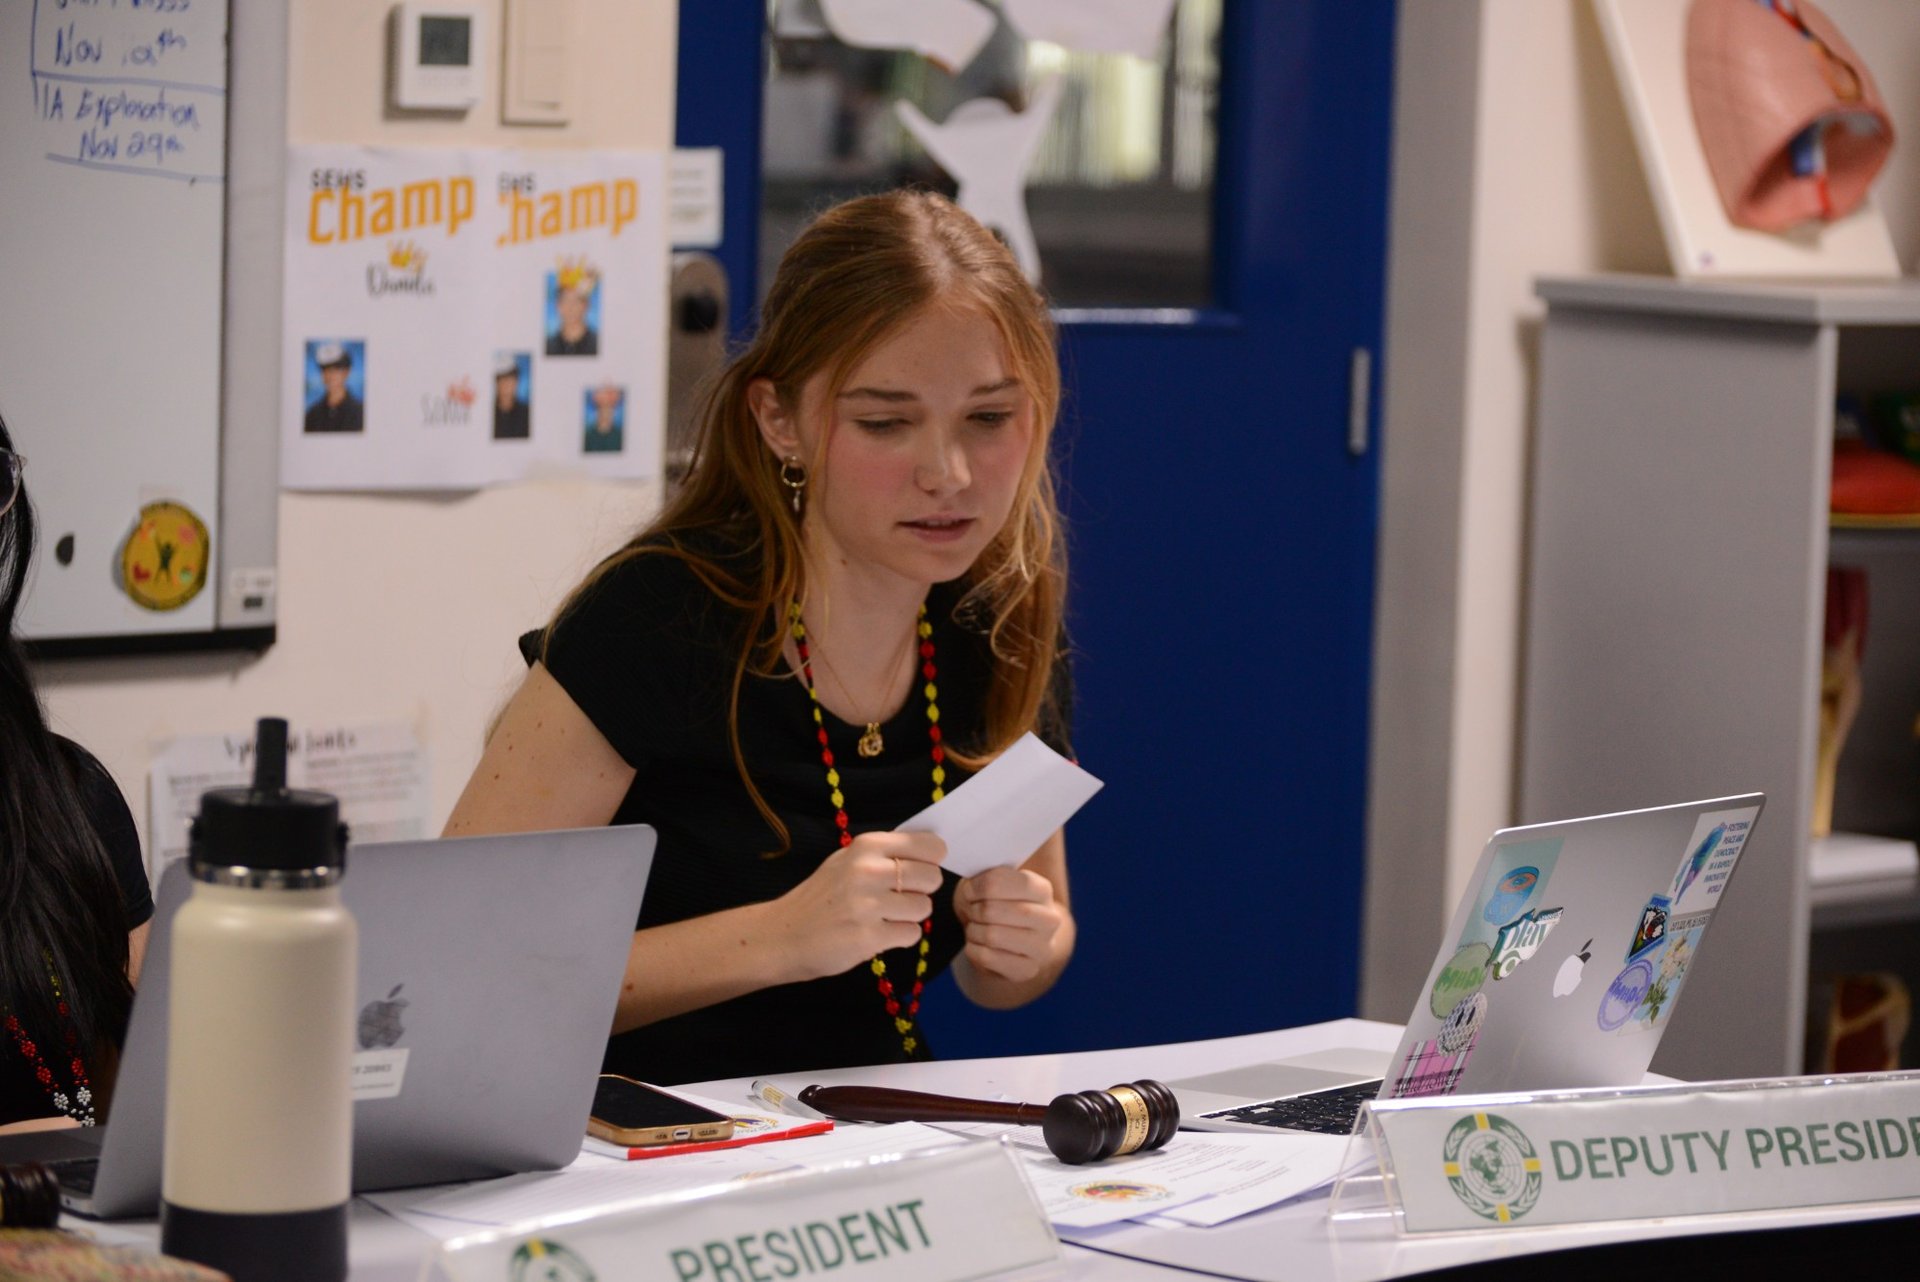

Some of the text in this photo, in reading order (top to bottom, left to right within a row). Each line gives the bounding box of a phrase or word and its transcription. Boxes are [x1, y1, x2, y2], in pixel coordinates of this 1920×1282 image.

[308, 174, 476, 246] Champ
[1549, 1129, 1731, 1182] DEPUTY
[669, 1198, 931, 1282] PRESIDENT
